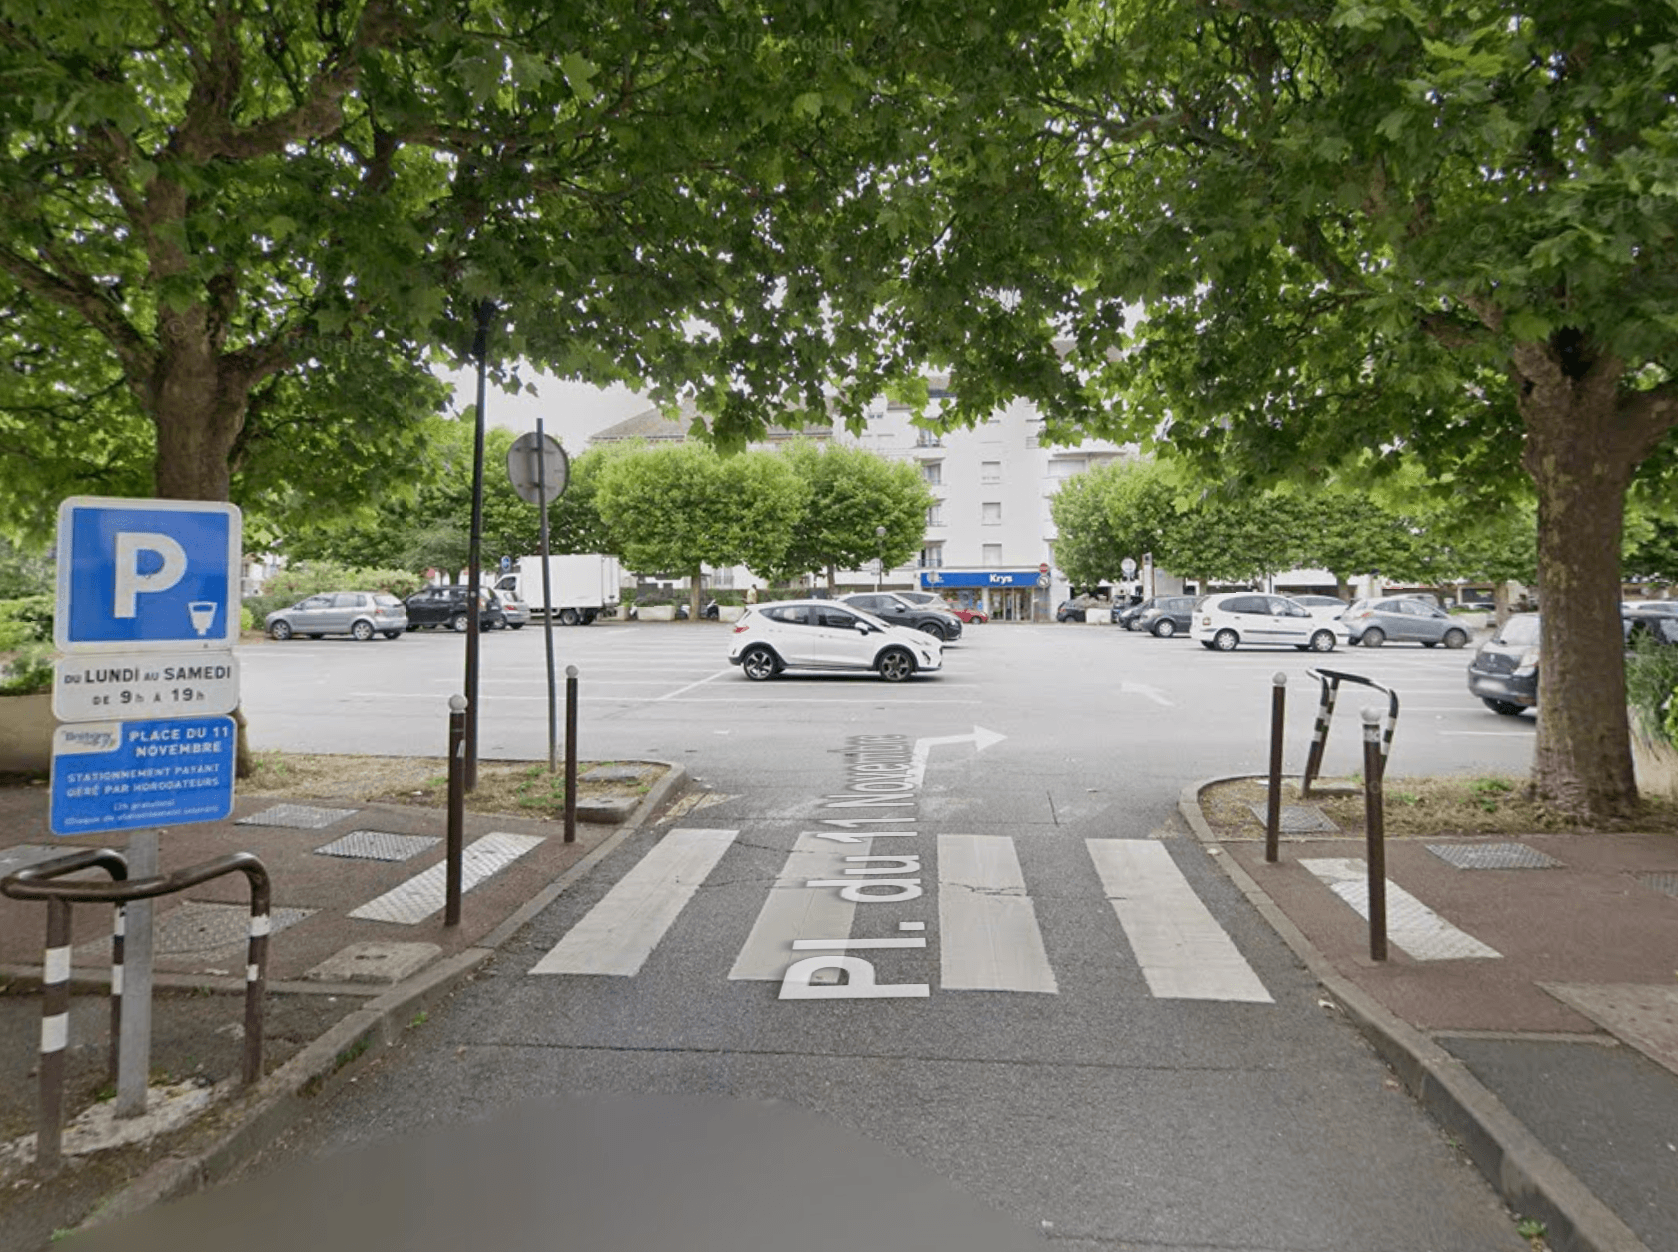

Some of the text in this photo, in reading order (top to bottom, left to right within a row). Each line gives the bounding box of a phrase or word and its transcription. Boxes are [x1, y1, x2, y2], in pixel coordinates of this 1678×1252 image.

[114, 532, 188, 618] P
[990, 574, 1013, 585] Krys
[64, 666, 231, 684] DU LUNDI AU SAMEDI
[92, 696, 110, 705] DE
[172, 688, 205, 701] 19h
[128, 726, 229, 742] PLACE DU 11
[135, 741, 222, 758] NOVEMBRE
[67, 763, 220, 783] STATIONNEMENT PAYANT
[104, 783, 130, 795] PAR
[133, 777, 219, 792] HORODATEURS
